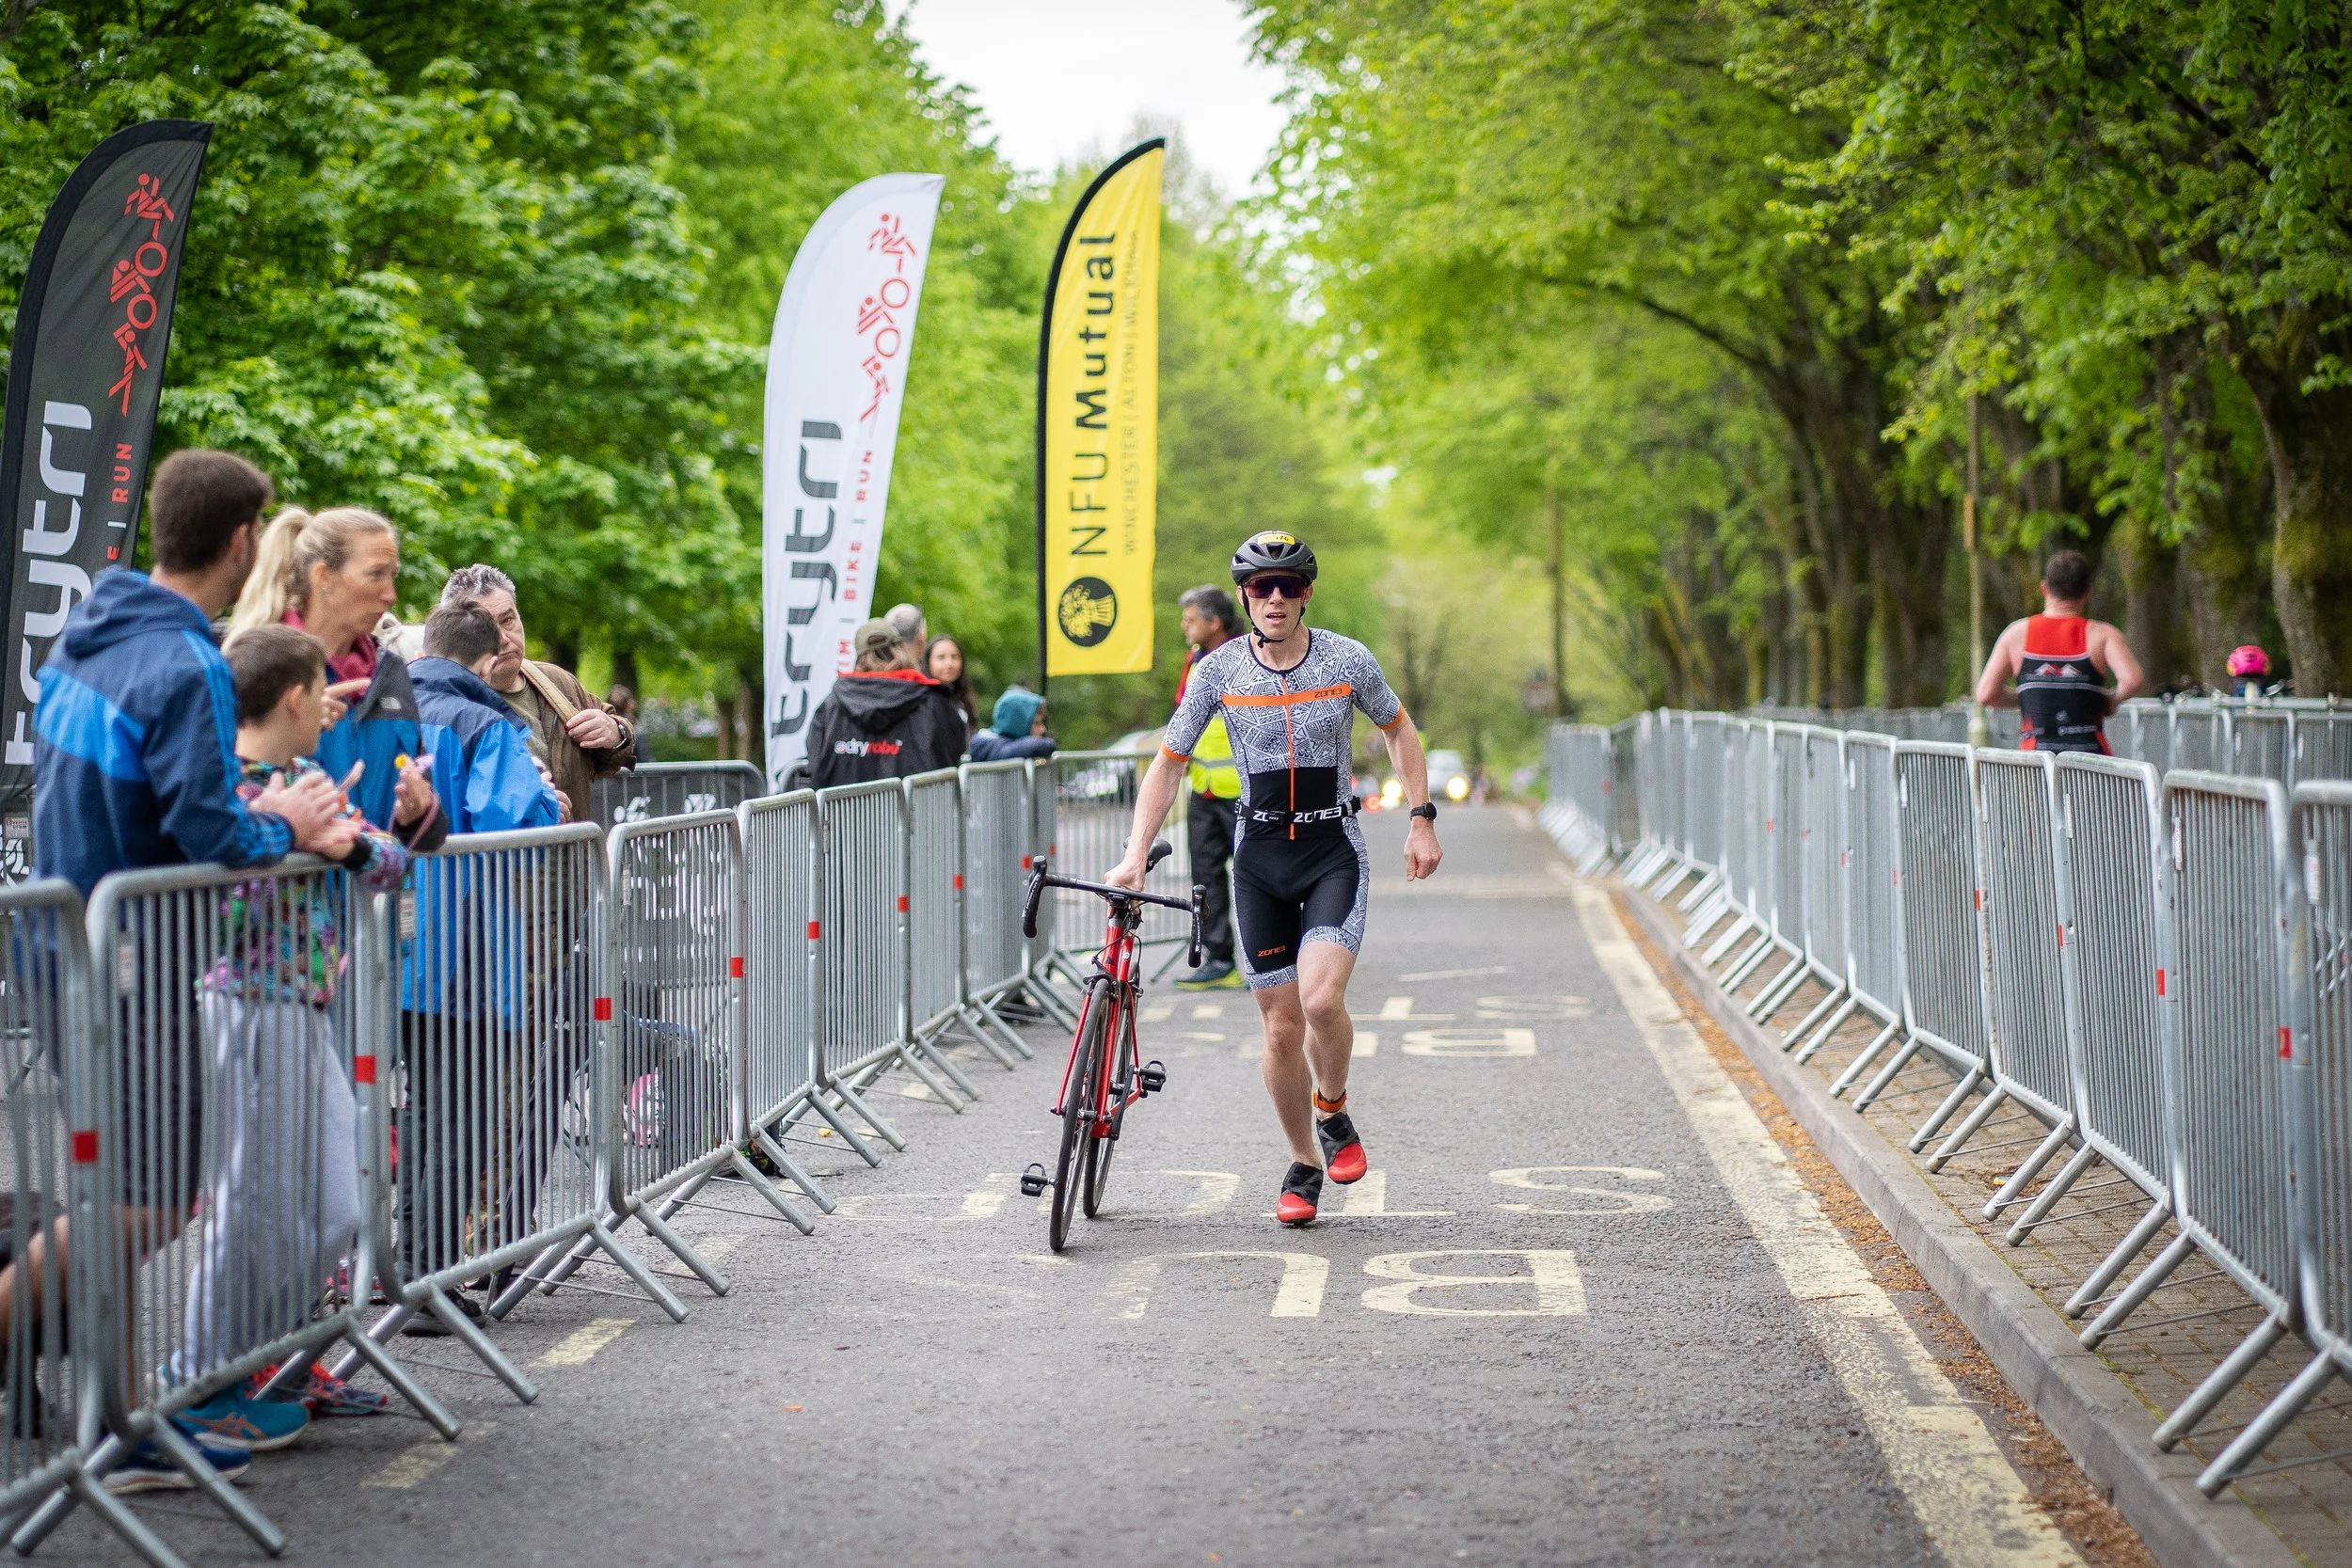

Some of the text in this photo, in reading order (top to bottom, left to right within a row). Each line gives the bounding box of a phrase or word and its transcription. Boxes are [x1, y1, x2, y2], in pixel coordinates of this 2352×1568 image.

[1070, 232, 1117, 556] NFU Mutual
[1121, 342, 1138, 411] ALTON
[111, 442, 134, 503] RUN
[843, 540, 863, 602] BIKE
[856, 450, 873, 503] RUN
[1121, 425, 1139, 555] WINCHESTER
[770, 420, 842, 738] trytri
[1294, 806, 1343, 823] ZONE3
